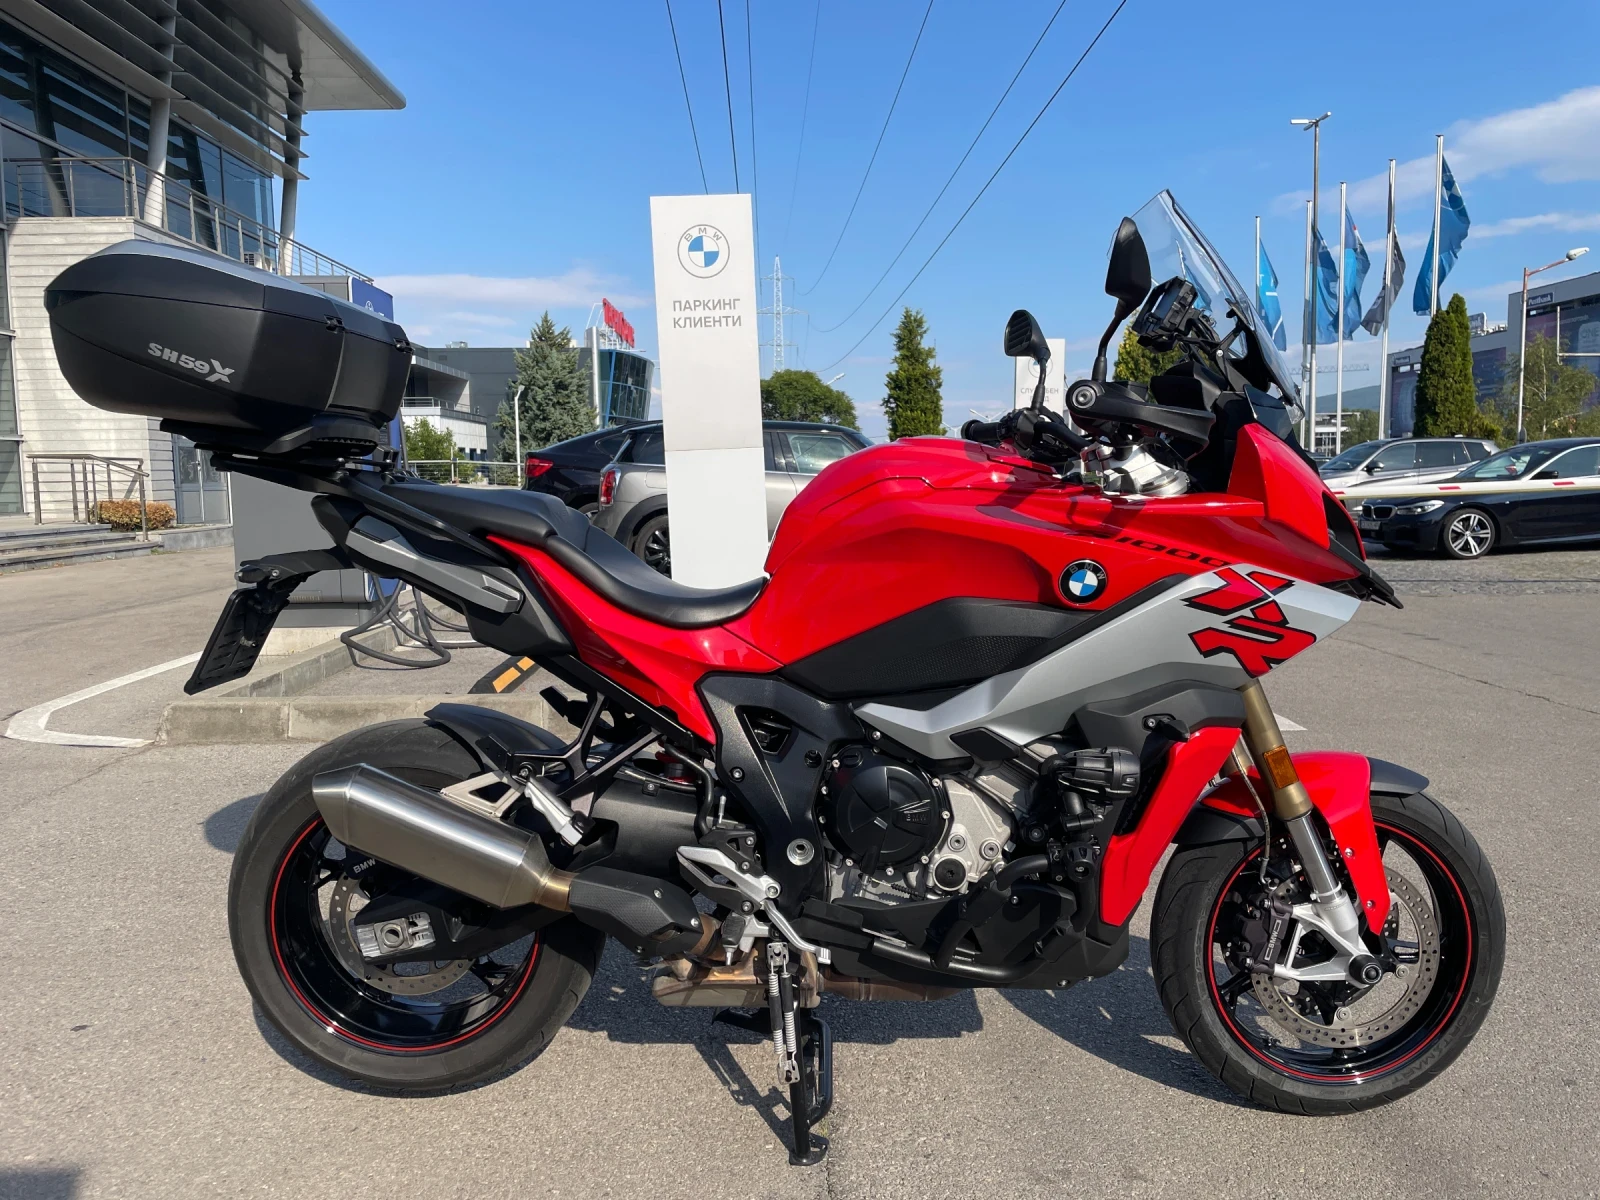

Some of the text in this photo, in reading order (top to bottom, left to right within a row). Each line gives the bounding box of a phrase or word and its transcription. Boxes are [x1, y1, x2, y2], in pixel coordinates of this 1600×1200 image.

[683, 226, 723, 243] BMW
[672, 298, 741, 312] ПАРКИНГ
[673, 315, 742, 329] КЛИЕНТИ
[1068, 562, 1107, 581] BMW
[352, 858, 376, 874] BMW
[1268, 930, 1279, 949] BMW
